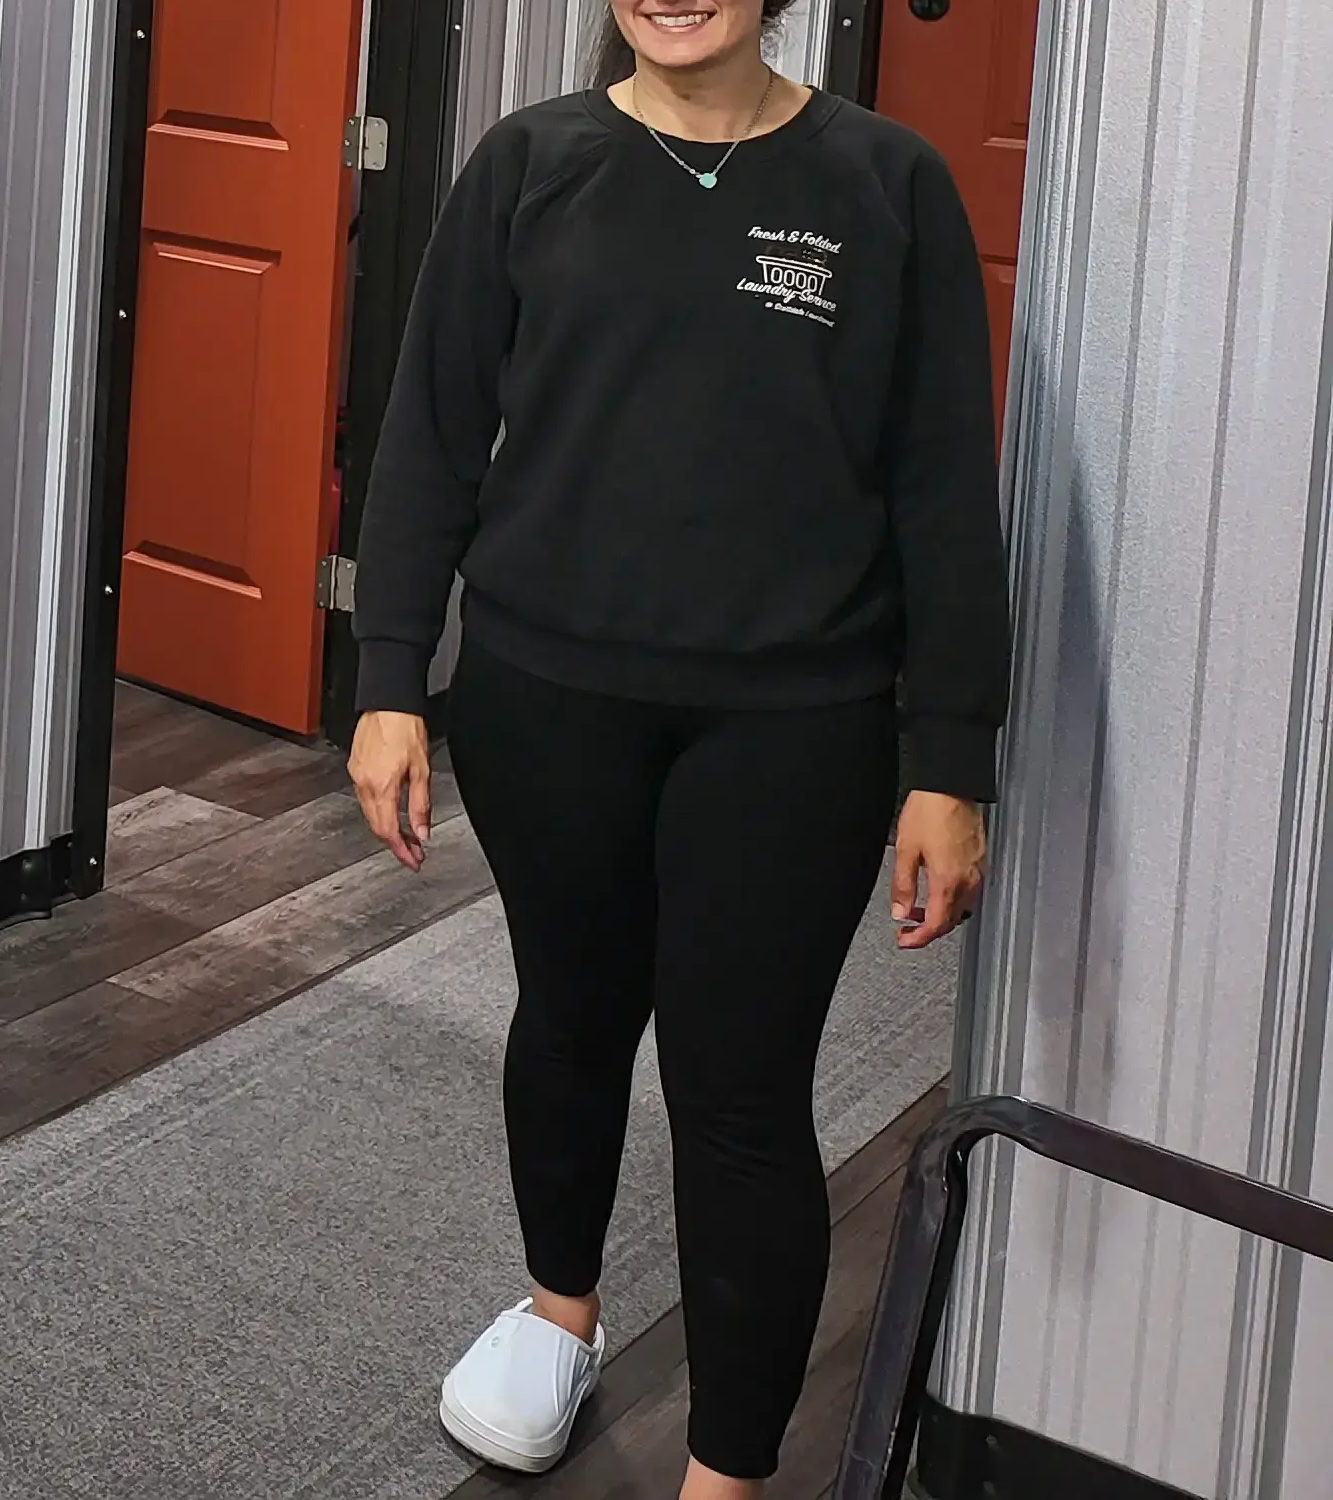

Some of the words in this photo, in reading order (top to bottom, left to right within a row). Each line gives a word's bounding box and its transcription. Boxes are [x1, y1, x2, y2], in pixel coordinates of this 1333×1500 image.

[747, 226, 786, 242] Fresh
[787, 230, 800, 243] &
[799, 231, 843, 254] Folded
[736, 277, 798, 303] Laundry
